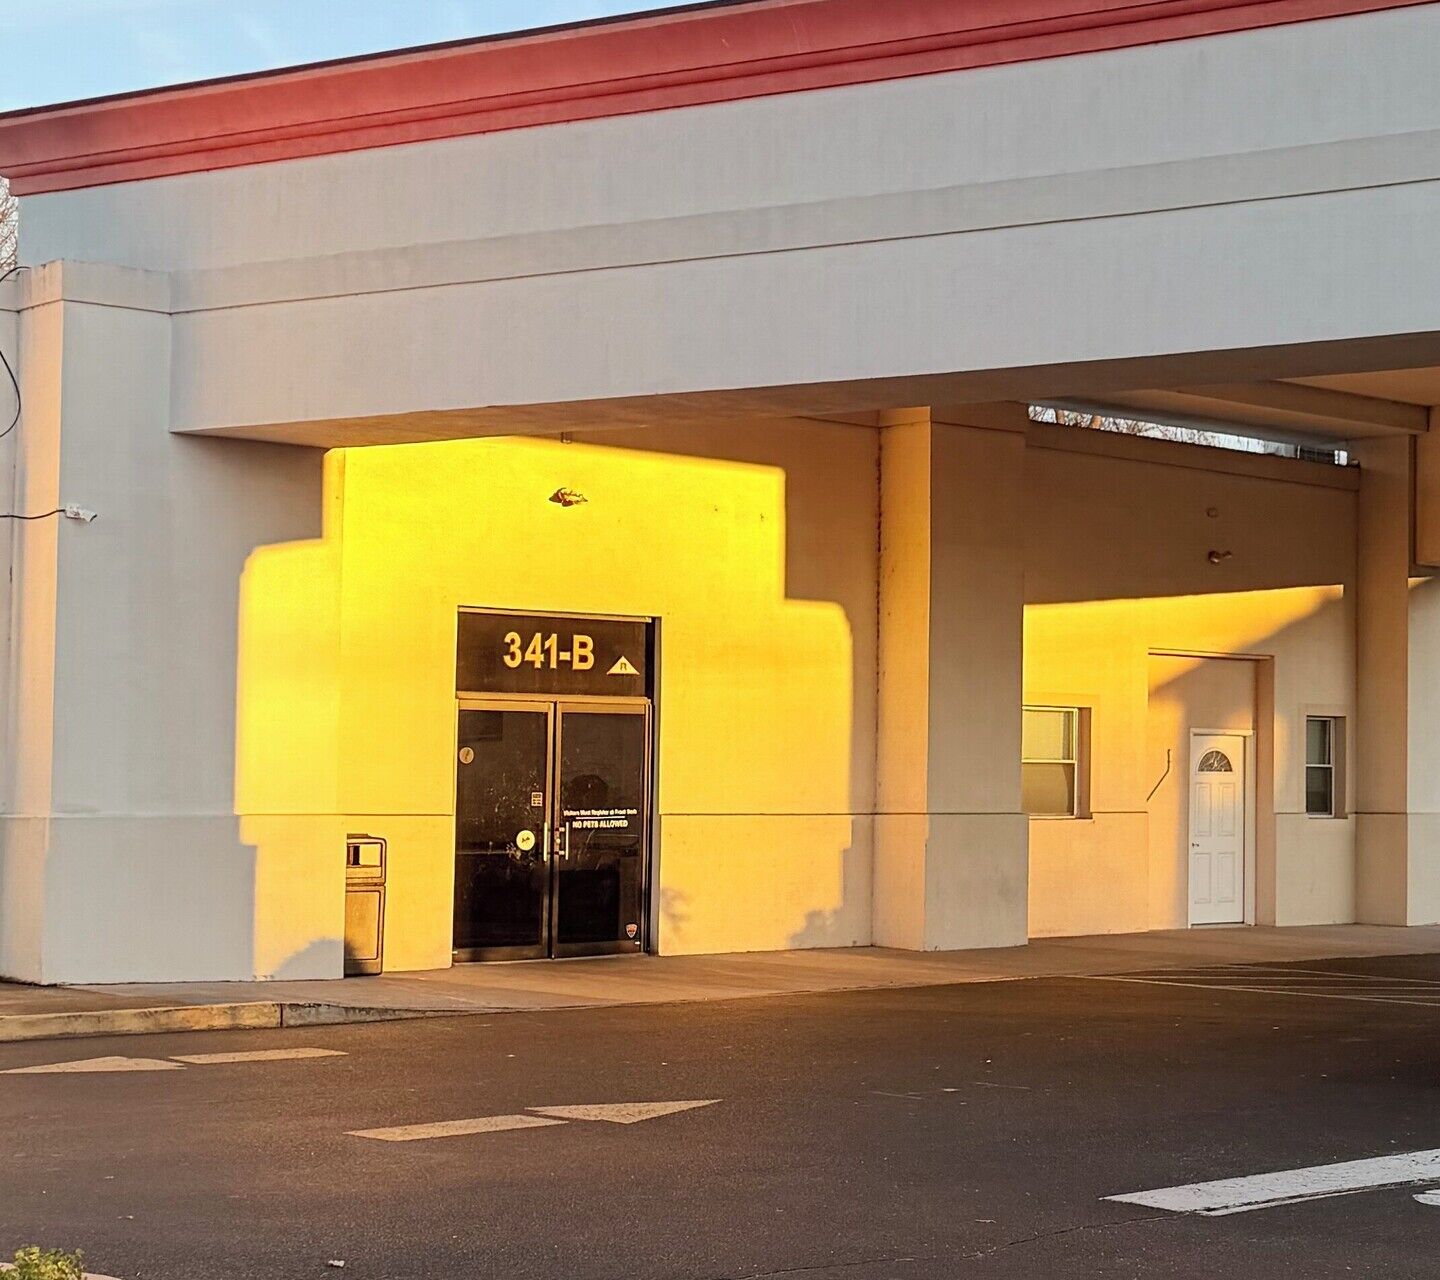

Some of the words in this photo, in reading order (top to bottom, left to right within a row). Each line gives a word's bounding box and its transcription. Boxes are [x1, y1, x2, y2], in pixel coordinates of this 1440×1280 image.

[503, 631, 595, 671] 341-B
[583, 820, 598, 828] PETS
[600, 820, 628, 828] ALLOWED
